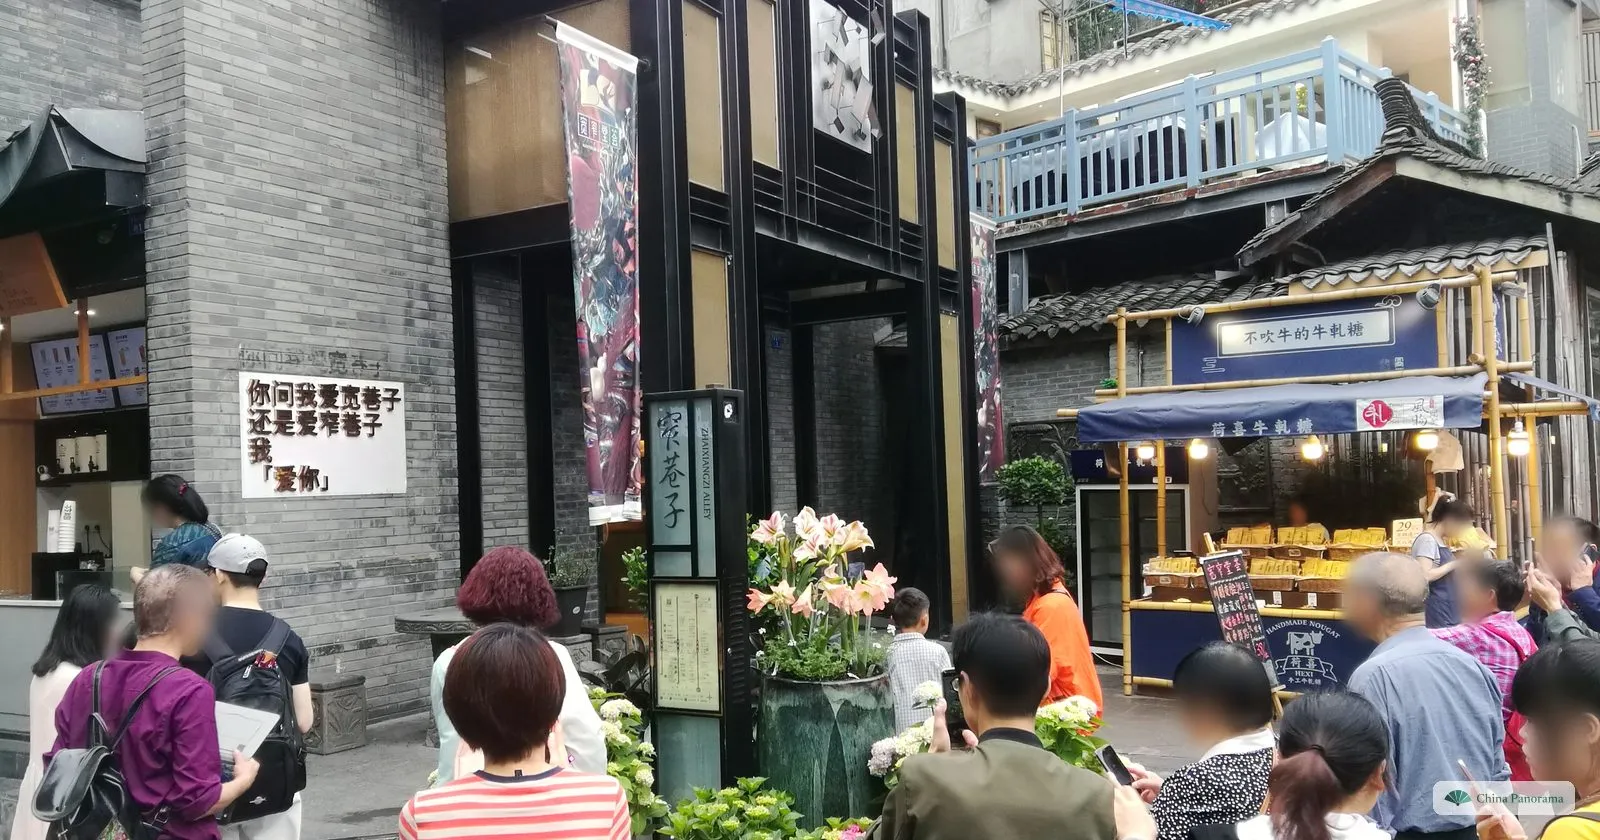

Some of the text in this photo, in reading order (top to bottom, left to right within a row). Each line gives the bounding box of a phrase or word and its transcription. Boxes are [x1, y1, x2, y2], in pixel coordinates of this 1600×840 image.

[247, 378, 402, 412] 你问我爱宽巷子
[248, 408, 383, 438] 还是爱窄巷子
[248, 437, 273, 465] 我
[657, 411, 686, 529] 窄巷子
[700, 427, 712, 520] ZHAIXIANGZI ALLEY
[1396, 520, 1412, 532] 29
[1265, 619, 1308, 636] HANDMADE
[1308, 619, 1341, 639] NOUGAT
